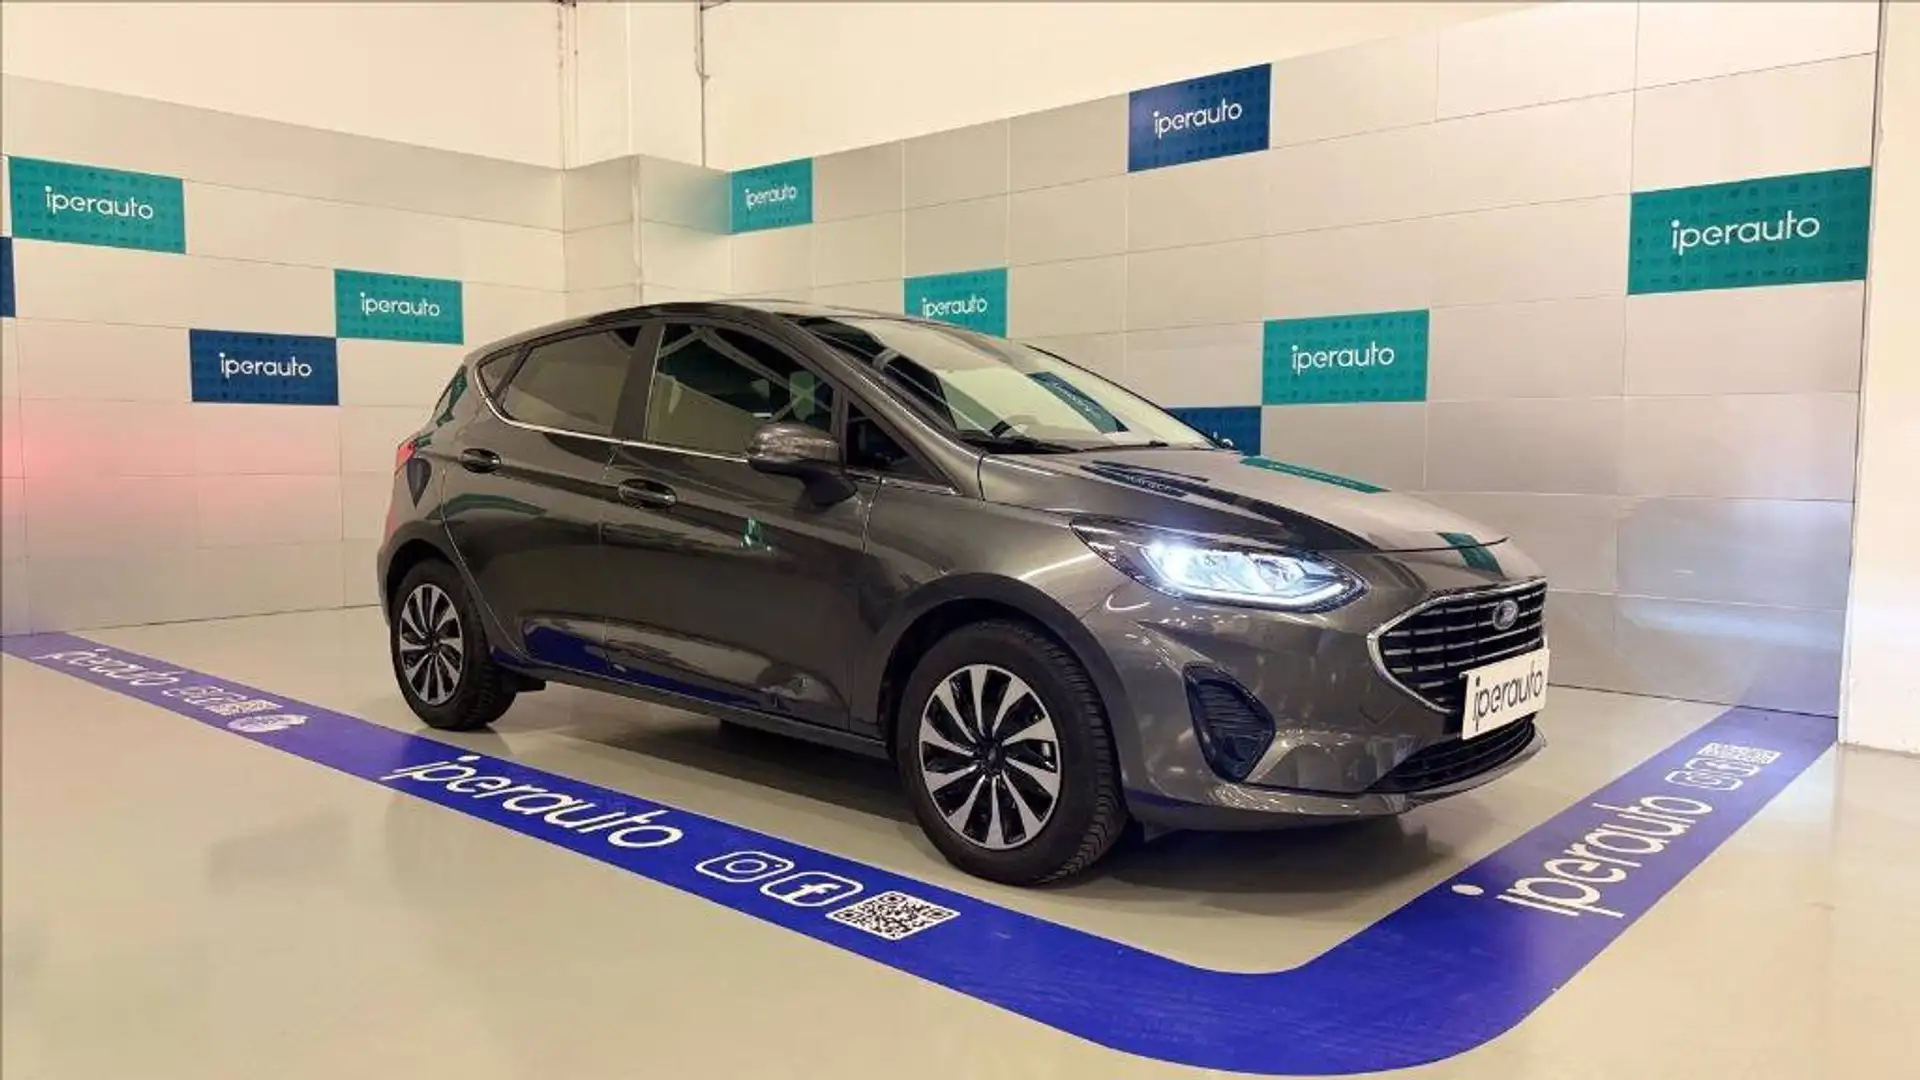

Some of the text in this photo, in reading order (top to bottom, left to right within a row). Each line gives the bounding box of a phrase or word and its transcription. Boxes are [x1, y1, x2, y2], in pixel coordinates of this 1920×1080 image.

[1153, 98, 1243, 139] iperauto
[44, 184, 154, 221] iperauto
[744, 183, 797, 211] iperauto
[1671, 209, 1820, 256] iperauto
[359, 292, 440, 318] iperauto
[922, 293, 988, 320] iperauto
[219, 352, 313, 379] iperauto
[1292, 340, 1395, 375] iperauto
[1472, 661, 1543, 733] iperauto
[379, 753, 684, 849] iperauto
[1451, 796, 1713, 919] iperauto
